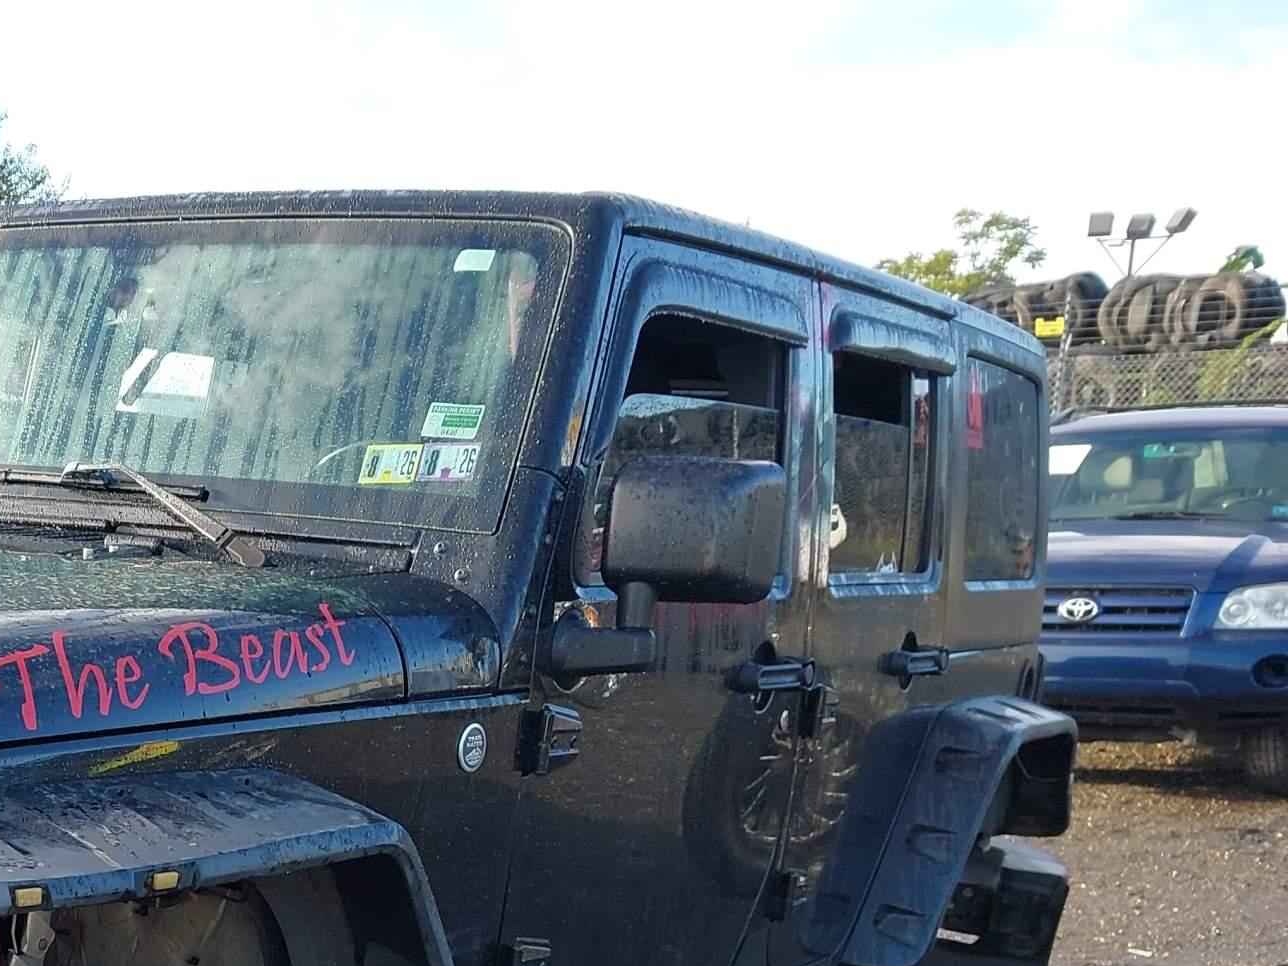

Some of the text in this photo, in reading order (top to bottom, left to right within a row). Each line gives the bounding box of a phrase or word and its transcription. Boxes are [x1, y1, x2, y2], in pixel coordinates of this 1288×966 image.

[367, 450, 418, 478] 8 26
[426, 448, 477, 476] 8 26
[158, 602, 357, 697] Beast
